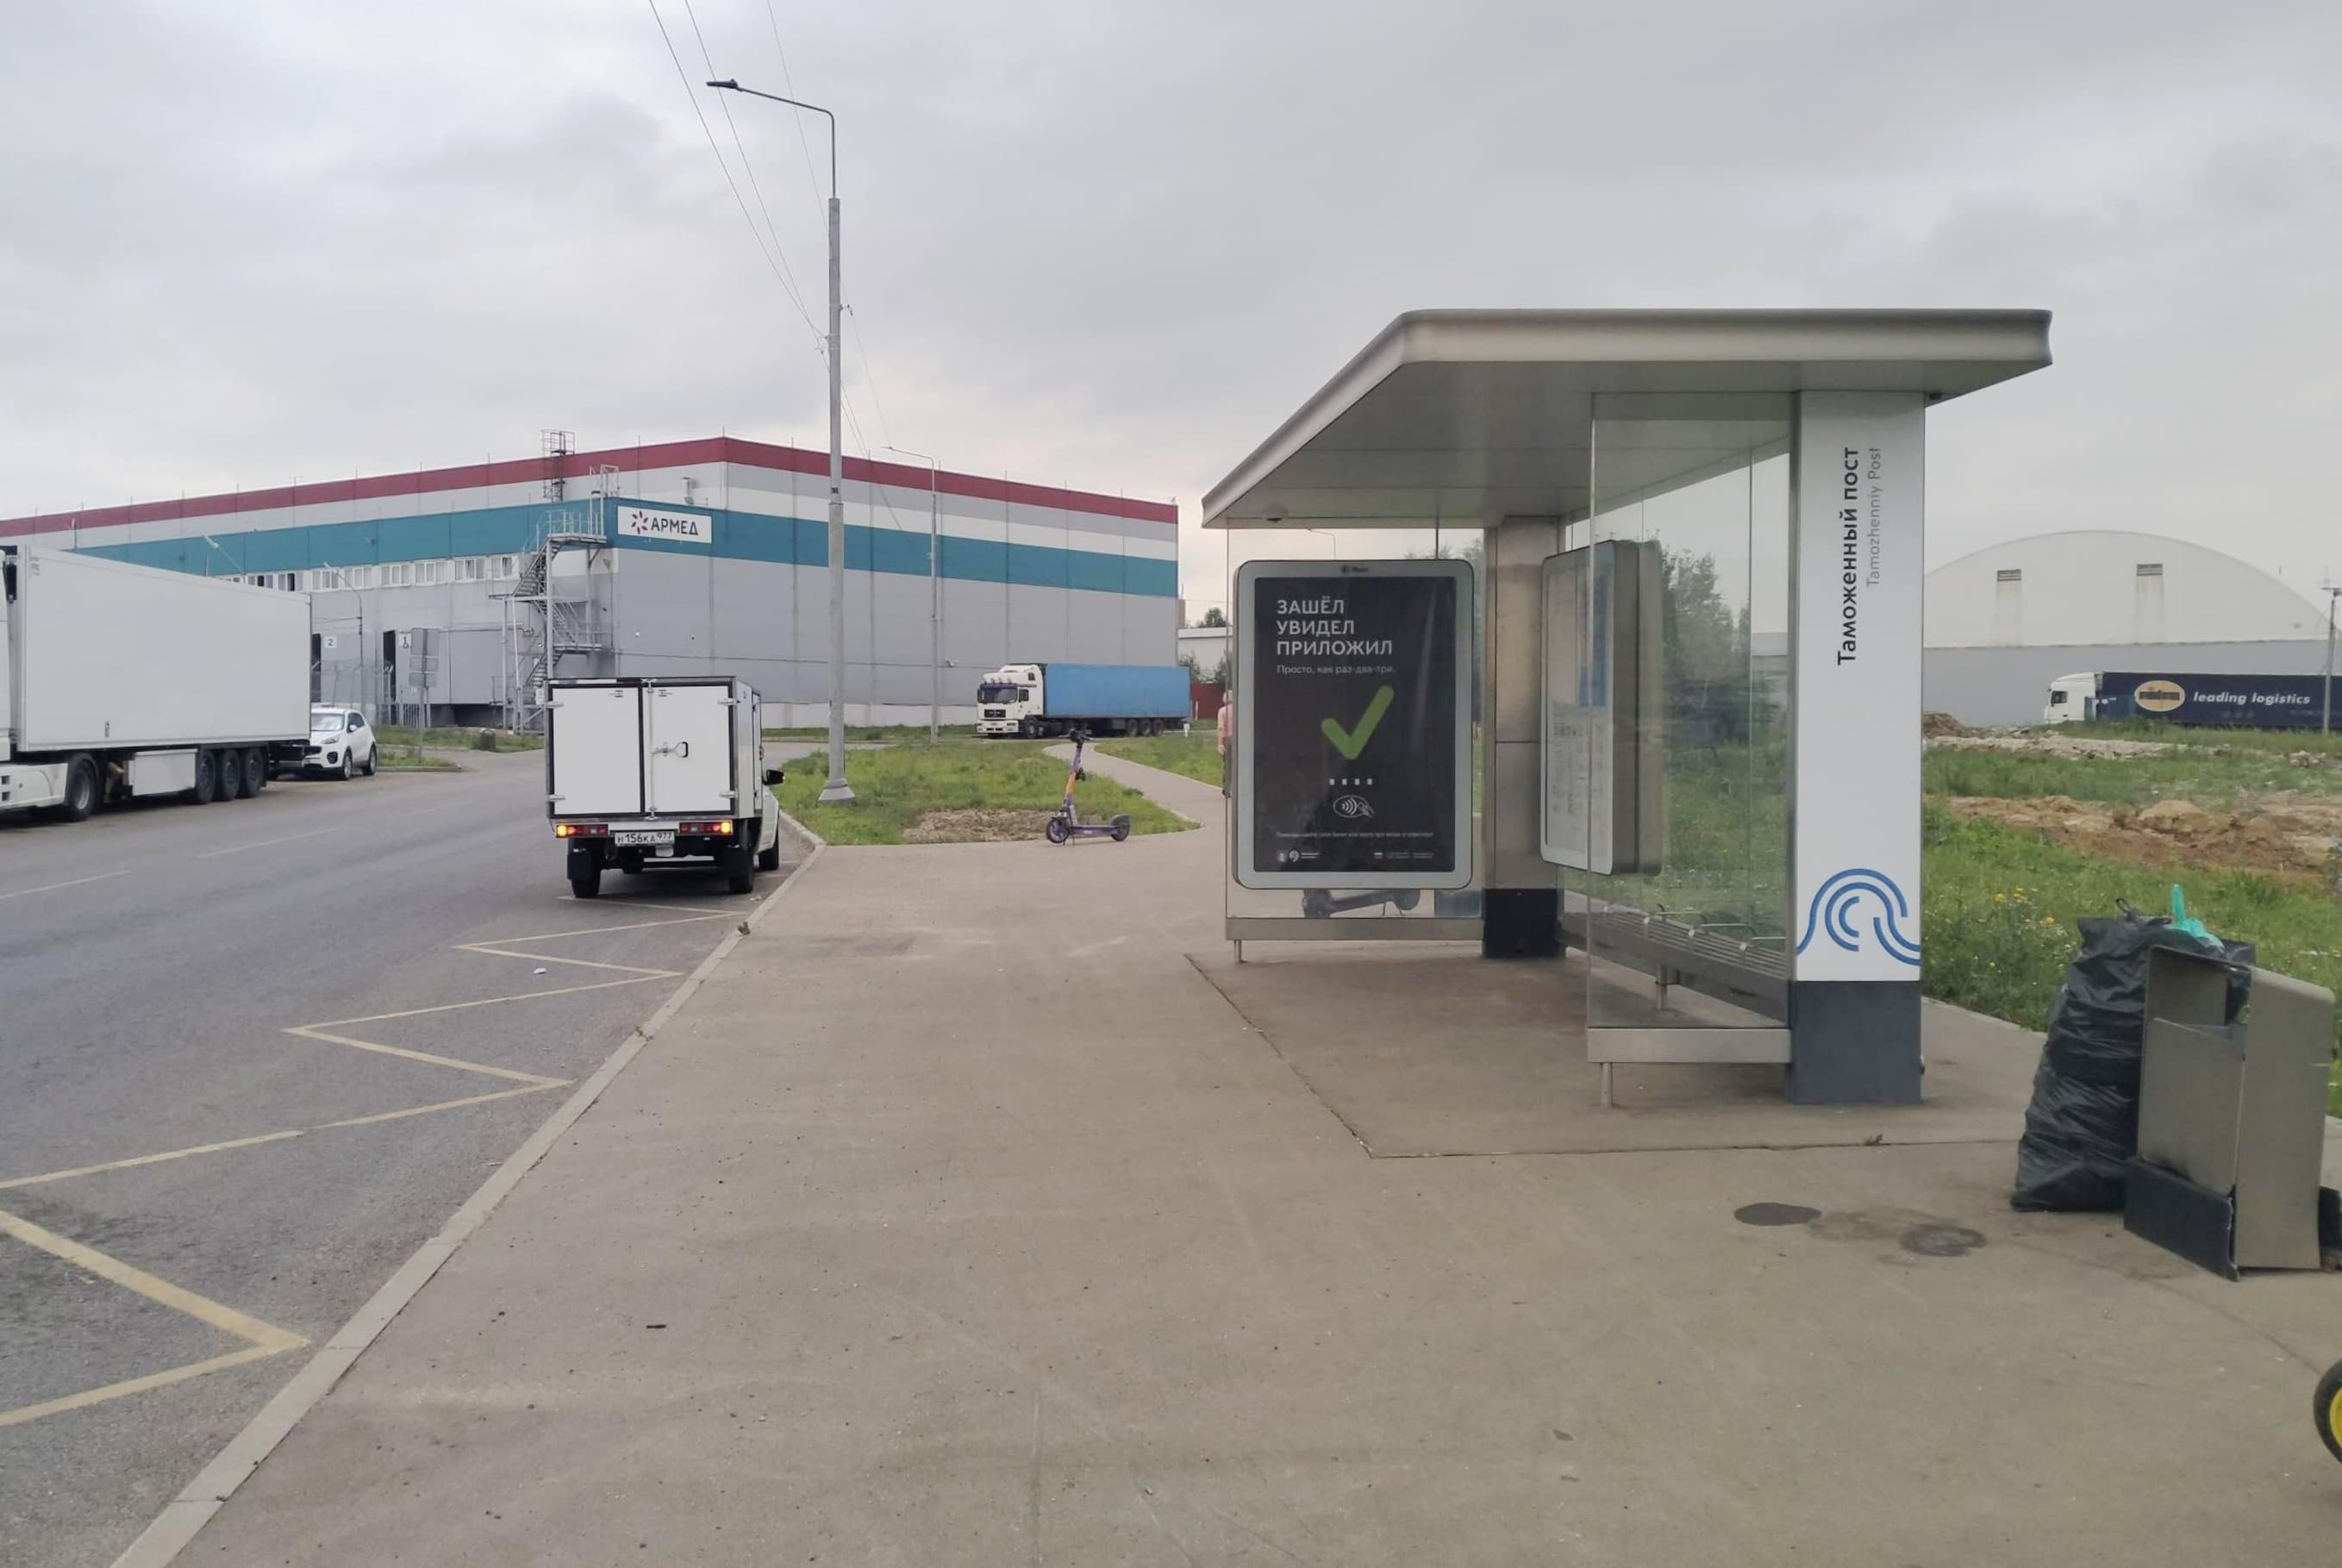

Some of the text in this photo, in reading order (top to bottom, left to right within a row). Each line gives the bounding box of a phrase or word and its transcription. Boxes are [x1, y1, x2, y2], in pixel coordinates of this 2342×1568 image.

[1866, 447, 1883, 587] Tamozhenniy Post
[651, 517, 698, 535] АРМЕД
[1837, 447, 1858, 665] Таможенный пост
[1277, 596, 1345, 615] ЗАШЁЛ
[1276, 620, 1355, 637] УВИДЕЛ
[1277, 640, 1393, 655] ПРИЛОЖИЛ
[1277, 665, 1315, 675] Просто,
[2193, 691, 2247, 706] leading
[2251, 692, 2311, 707] logistics
